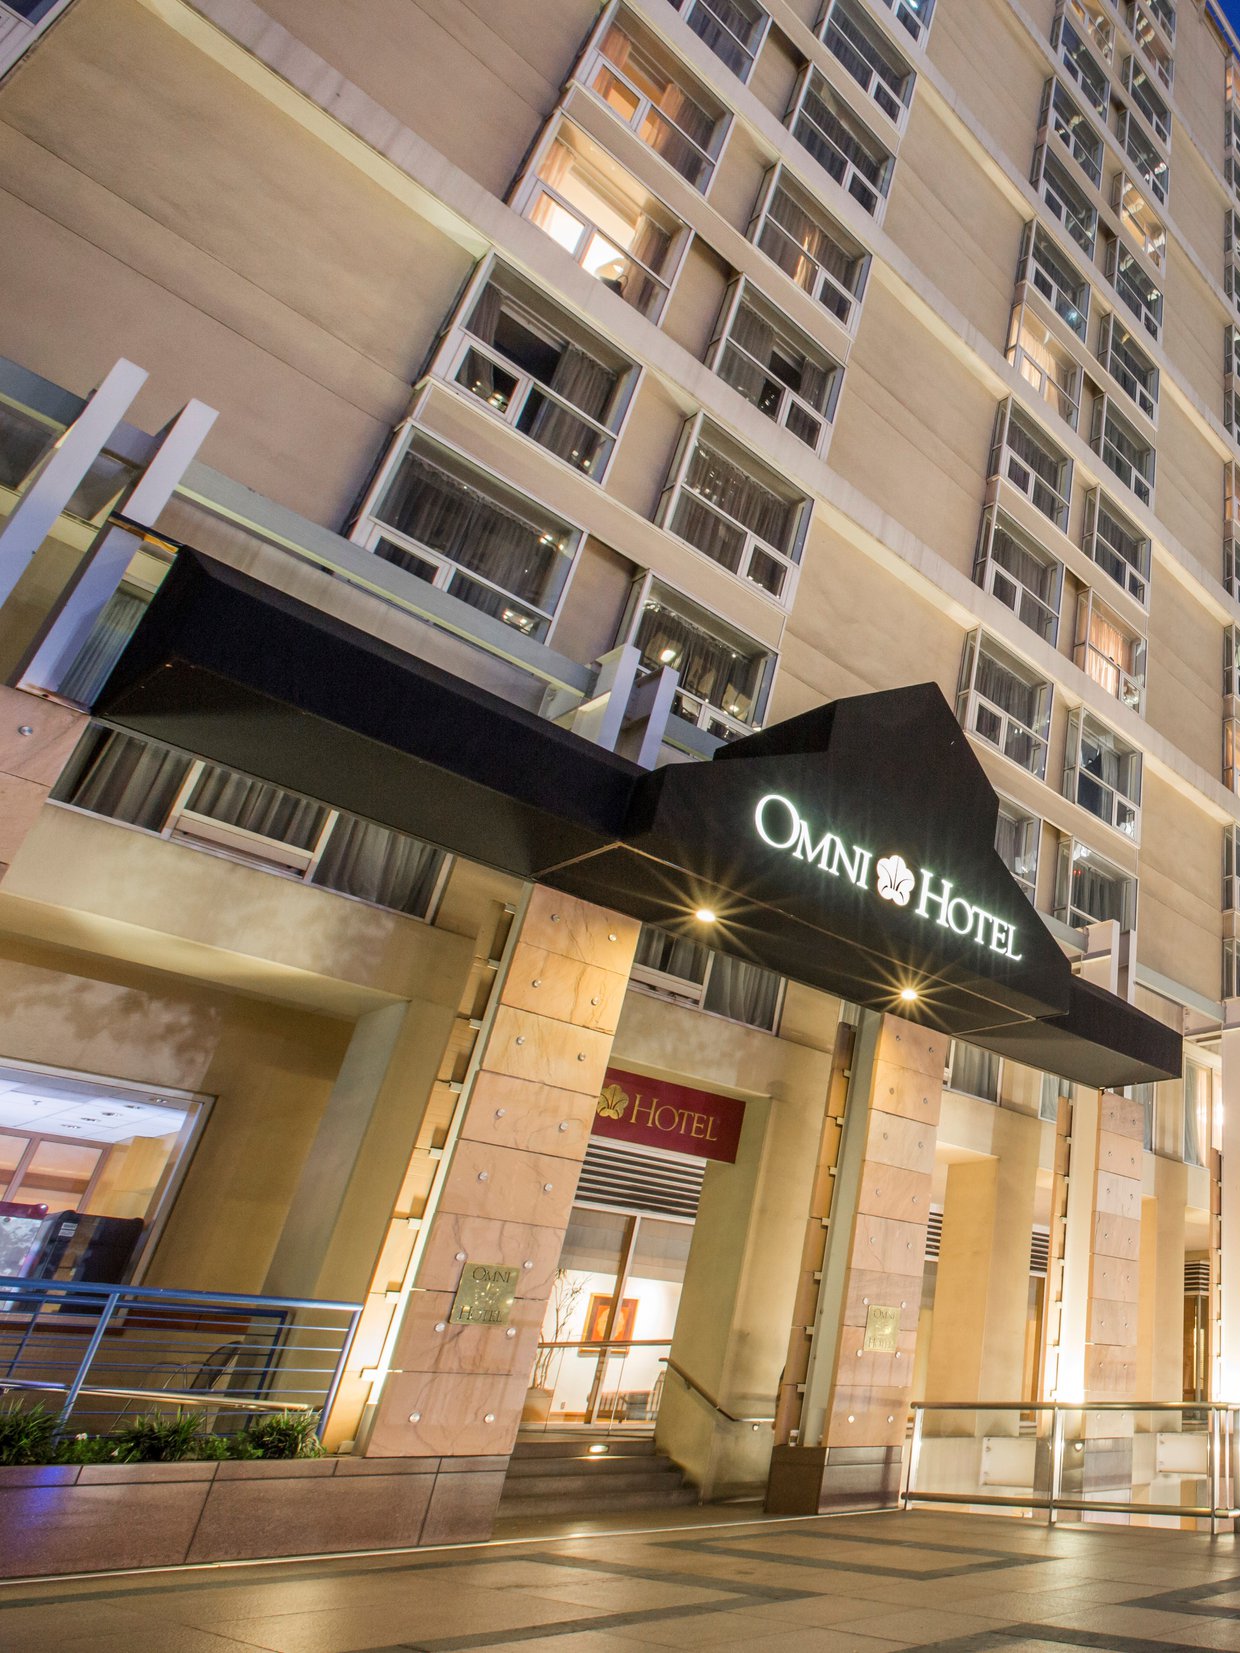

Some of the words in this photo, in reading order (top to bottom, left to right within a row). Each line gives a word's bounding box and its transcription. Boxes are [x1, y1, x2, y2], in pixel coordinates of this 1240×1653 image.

[754, 794, 873, 890] OMNI
[915, 868, 1022, 961] HOTEL
[629, 1093, 718, 1142] HOTEL
[472, 1266, 511, 1283] OMNI
[458, 1305, 503, 1322] HOTEL
